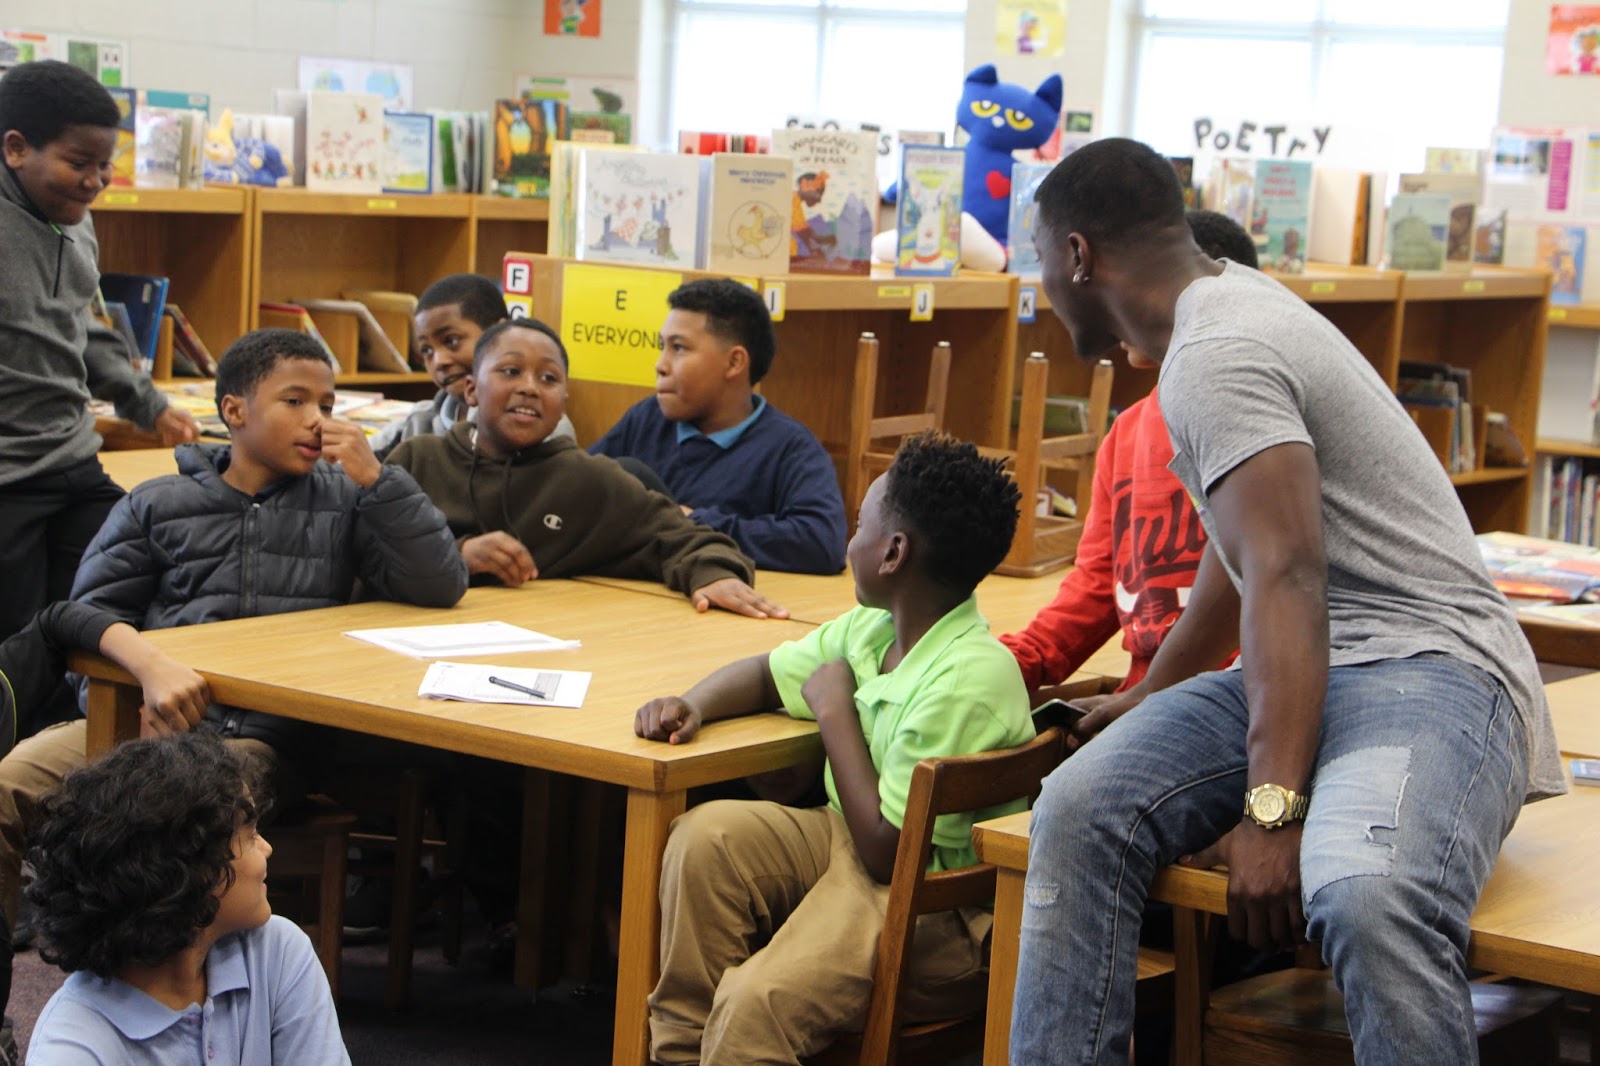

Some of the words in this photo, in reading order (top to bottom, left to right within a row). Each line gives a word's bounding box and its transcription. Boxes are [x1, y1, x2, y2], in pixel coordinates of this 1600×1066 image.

[512, 267, 524, 287] F
[616, 290, 627, 311] E
[918, 289, 928, 313] J
[1021, 296, 1031, 313] K
